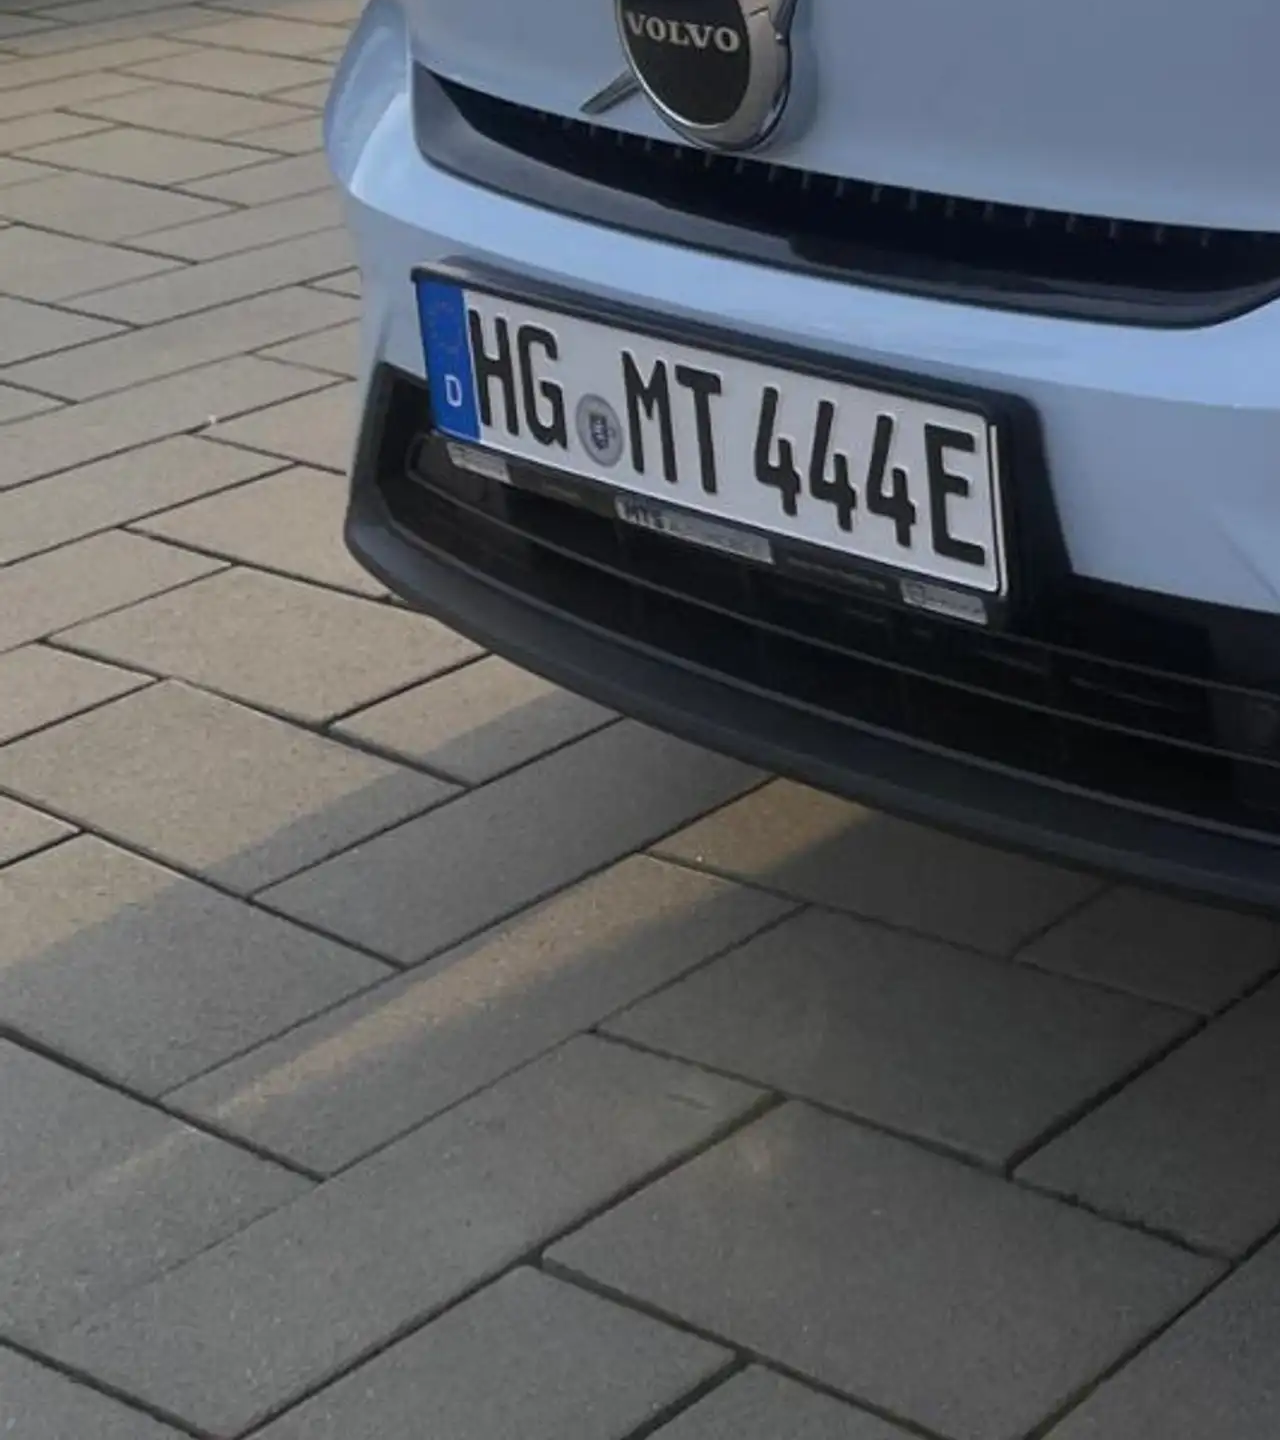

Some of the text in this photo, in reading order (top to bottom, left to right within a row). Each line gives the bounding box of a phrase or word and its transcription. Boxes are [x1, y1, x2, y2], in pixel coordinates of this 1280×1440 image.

[625, 12, 741, 52] VOLVO
[443, 376, 463, 408] D
[468, 308, 567, 450] HG
[621, 350, 722, 494] MT
[755, 386, 985, 565] 444E
